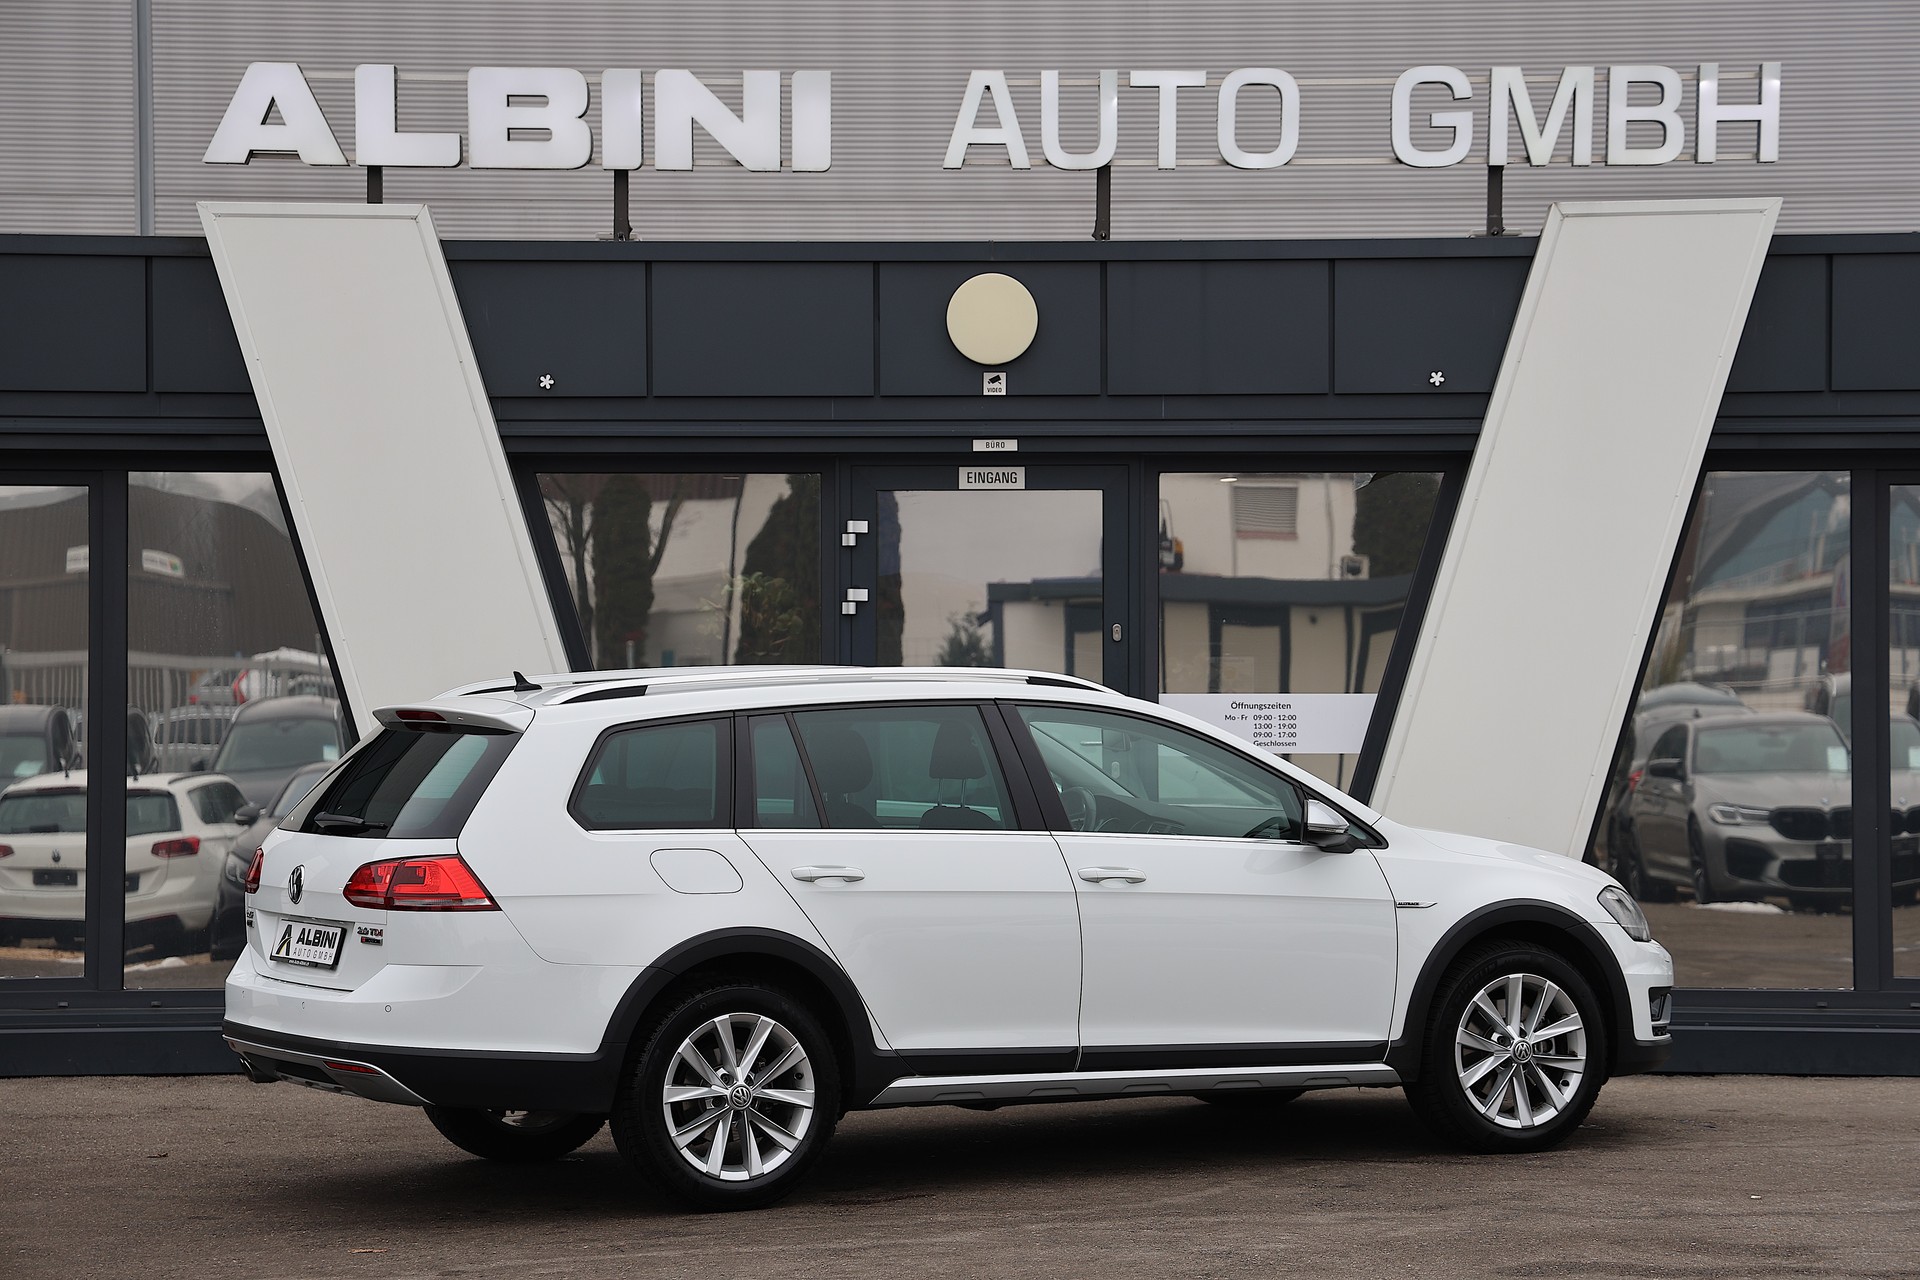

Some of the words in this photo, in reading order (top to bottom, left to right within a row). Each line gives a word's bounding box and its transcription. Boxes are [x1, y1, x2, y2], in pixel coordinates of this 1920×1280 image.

[202, 61, 833, 172] ALBINI
[943, 67, 1301, 170] AUTO
[1391, 61, 1782, 168] GMBH
[985, 441, 1006, 449] BÜRO
[966, 471, 1018, 484] EINGANG
[1230, 700, 1292, 711] Öffnungszeiten
[296, 928, 338, 949] ALBINI
[369, 928, 383, 937] TDI
[293, 947, 312, 958] AUTO
[313, 949, 333, 961] GMBH
